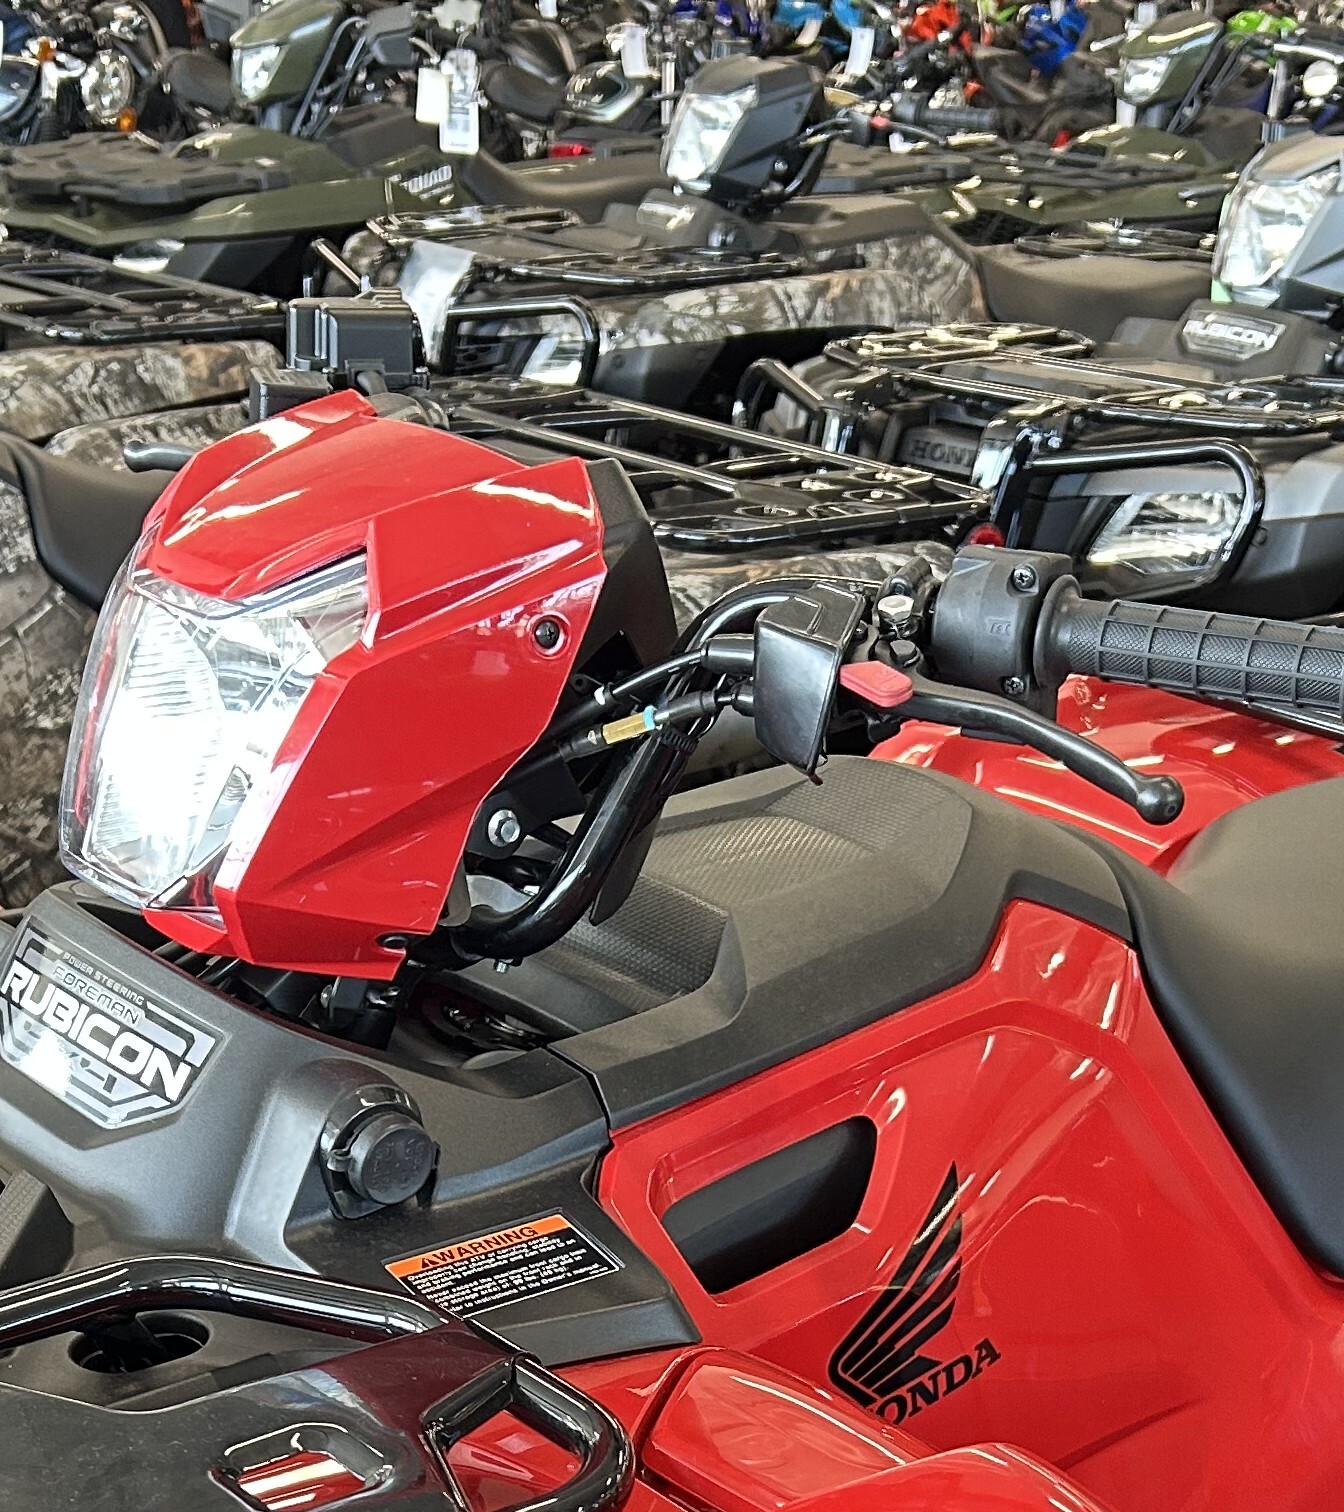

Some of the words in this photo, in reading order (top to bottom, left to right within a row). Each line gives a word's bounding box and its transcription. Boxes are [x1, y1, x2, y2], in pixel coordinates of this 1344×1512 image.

[1182, 320, 1278, 351] RUBICON
[52, 964, 140, 1025] FOREMAN
[62, 951, 94, 976] POWER
[93, 970, 145, 1006] STEERING
[0, 958, 193, 1102] RUBICON
[431, 1226, 539, 1263] WARNING
[870, 1337, 1002, 1425] ONDA
